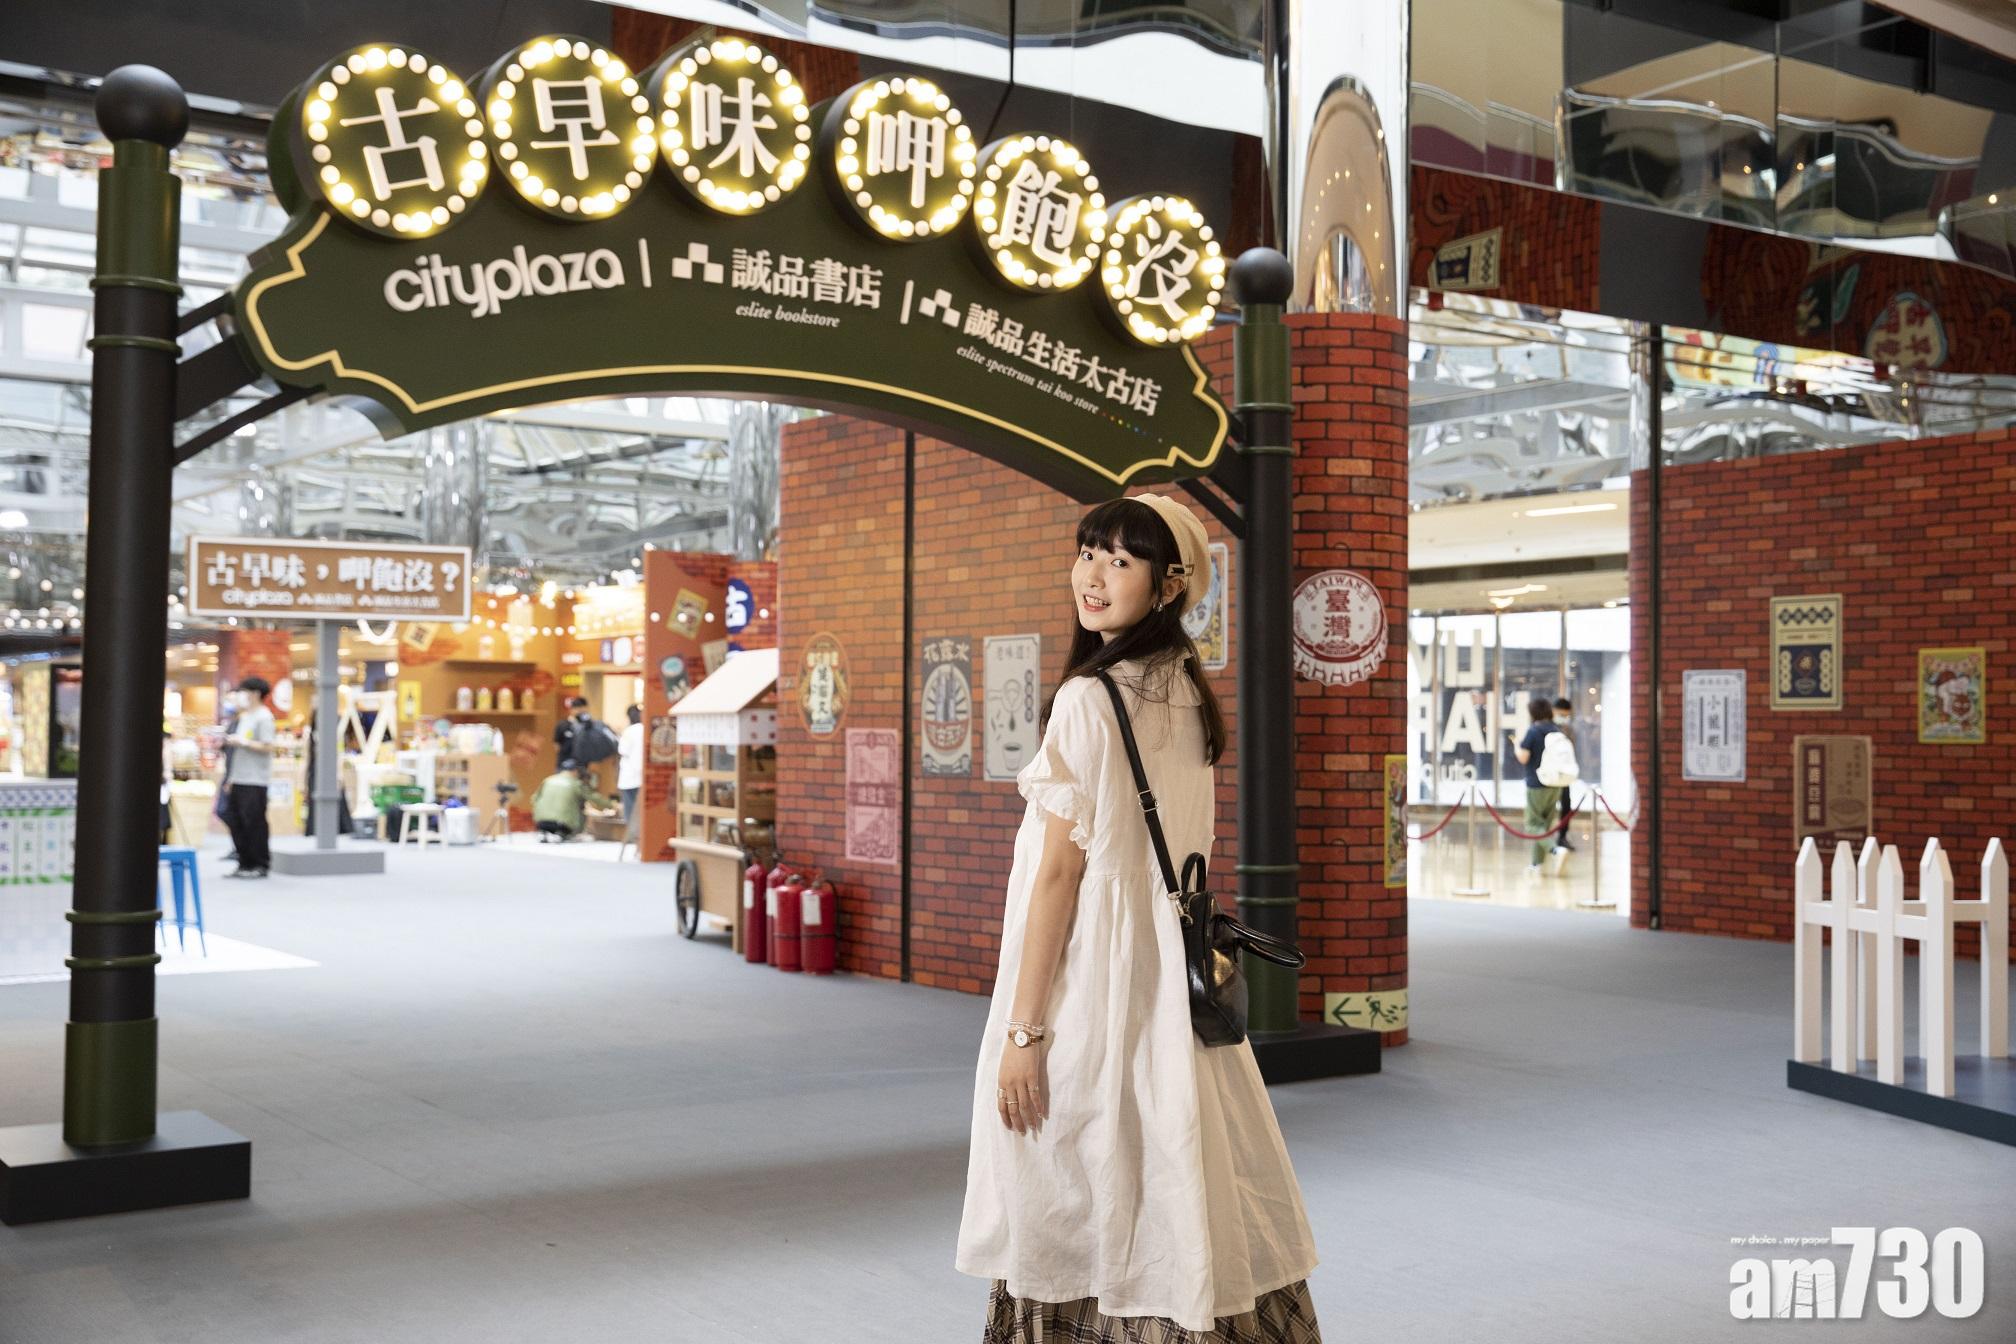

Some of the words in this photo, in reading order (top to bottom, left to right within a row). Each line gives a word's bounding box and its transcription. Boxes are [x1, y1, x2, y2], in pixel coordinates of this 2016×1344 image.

[383, 244, 625, 318] cityplaza
[731, 247, 883, 309] 誠品書店
[735, 301, 772, 319] eslite
[774, 304, 841, 328] bookstore
[956, 345, 985, 365] eslite
[985, 357, 1035, 387] spectrum
[1036, 378, 1053, 394] tai
[1054, 384, 1074, 403] koo
[1074, 395, 1100, 415] store
[963, 303, 1162, 417] 誠品生活太古店
[1312, 576, 1364, 593] TAIWAN
[1324, 589, 1351, 639] 臺灣
